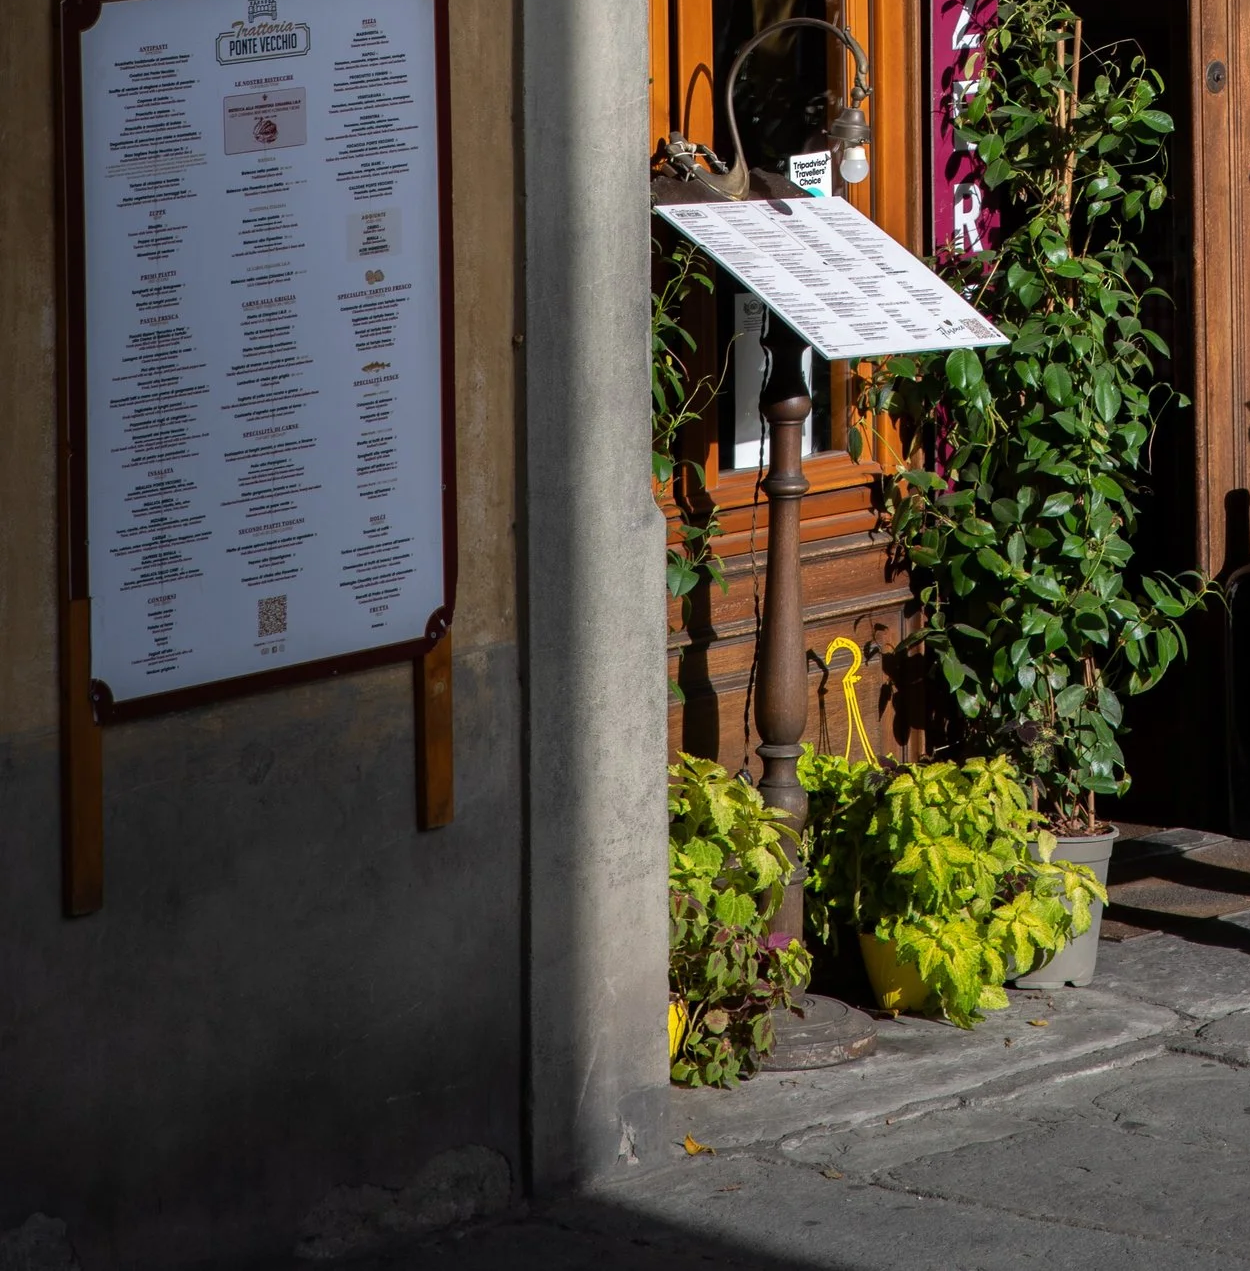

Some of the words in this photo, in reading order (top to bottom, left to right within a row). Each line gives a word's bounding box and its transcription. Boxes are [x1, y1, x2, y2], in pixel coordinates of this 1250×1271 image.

[232, 20, 294, 38] Trattoria
[229, 37, 258, 57] PONTE
[260, 33, 297, 53] VECCHIO
[800, 177, 821, 187] Choice
